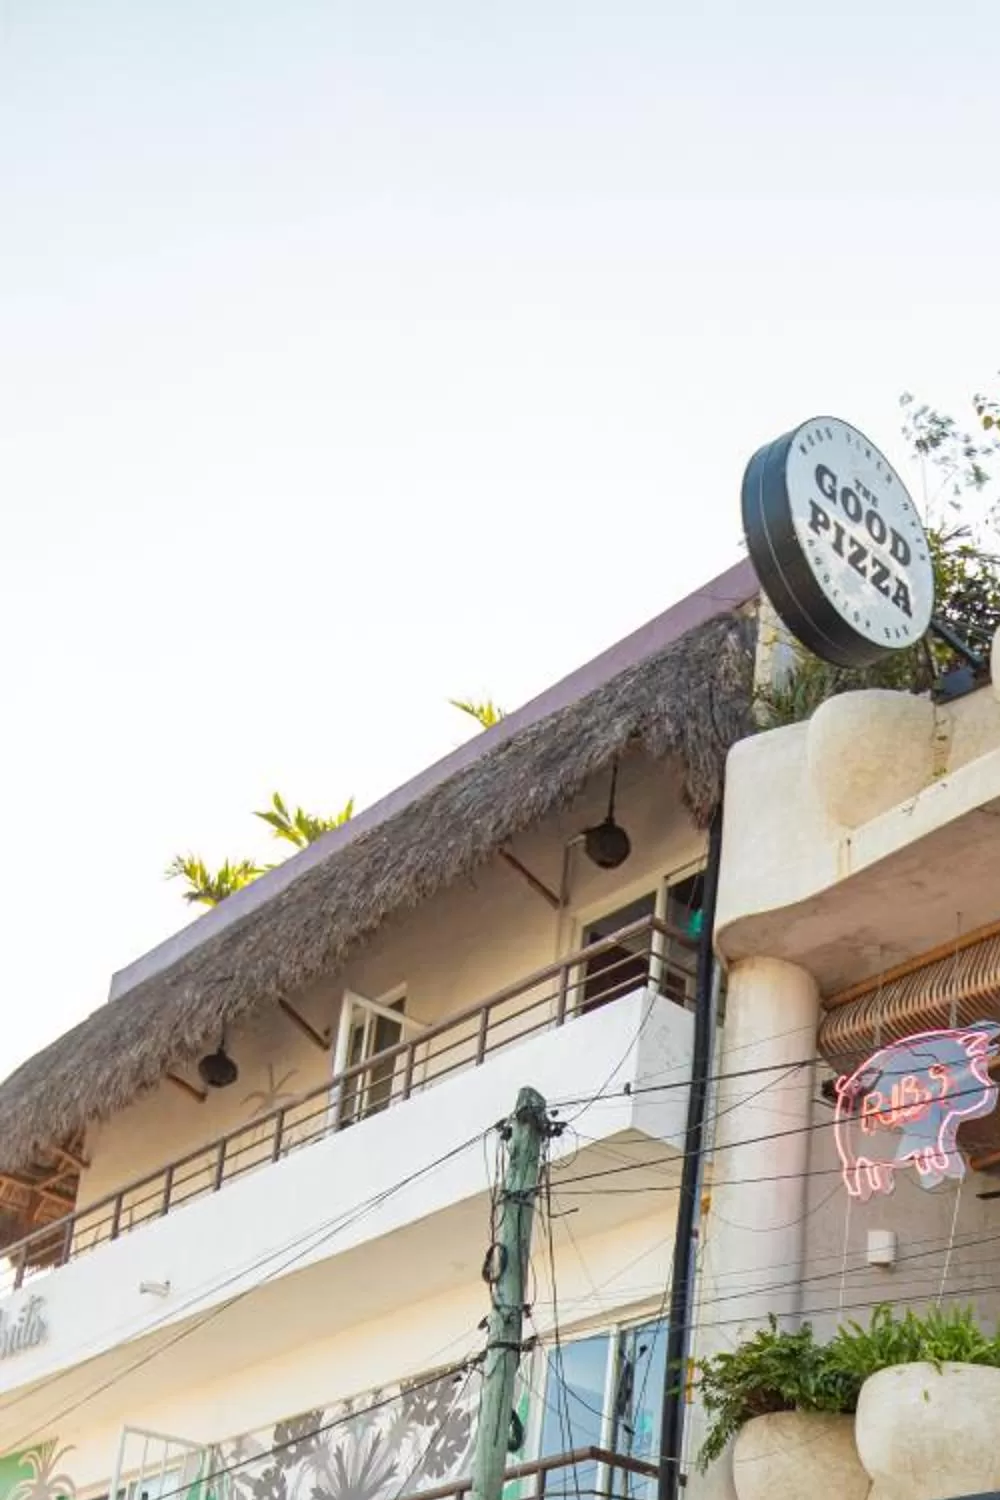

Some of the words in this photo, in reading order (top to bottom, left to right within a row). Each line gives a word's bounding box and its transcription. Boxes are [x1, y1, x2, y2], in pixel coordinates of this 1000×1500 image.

[815, 464, 911, 567] GOOD
[854, 479, 880, 508] THE
[808, 499, 913, 618] PIZZA
